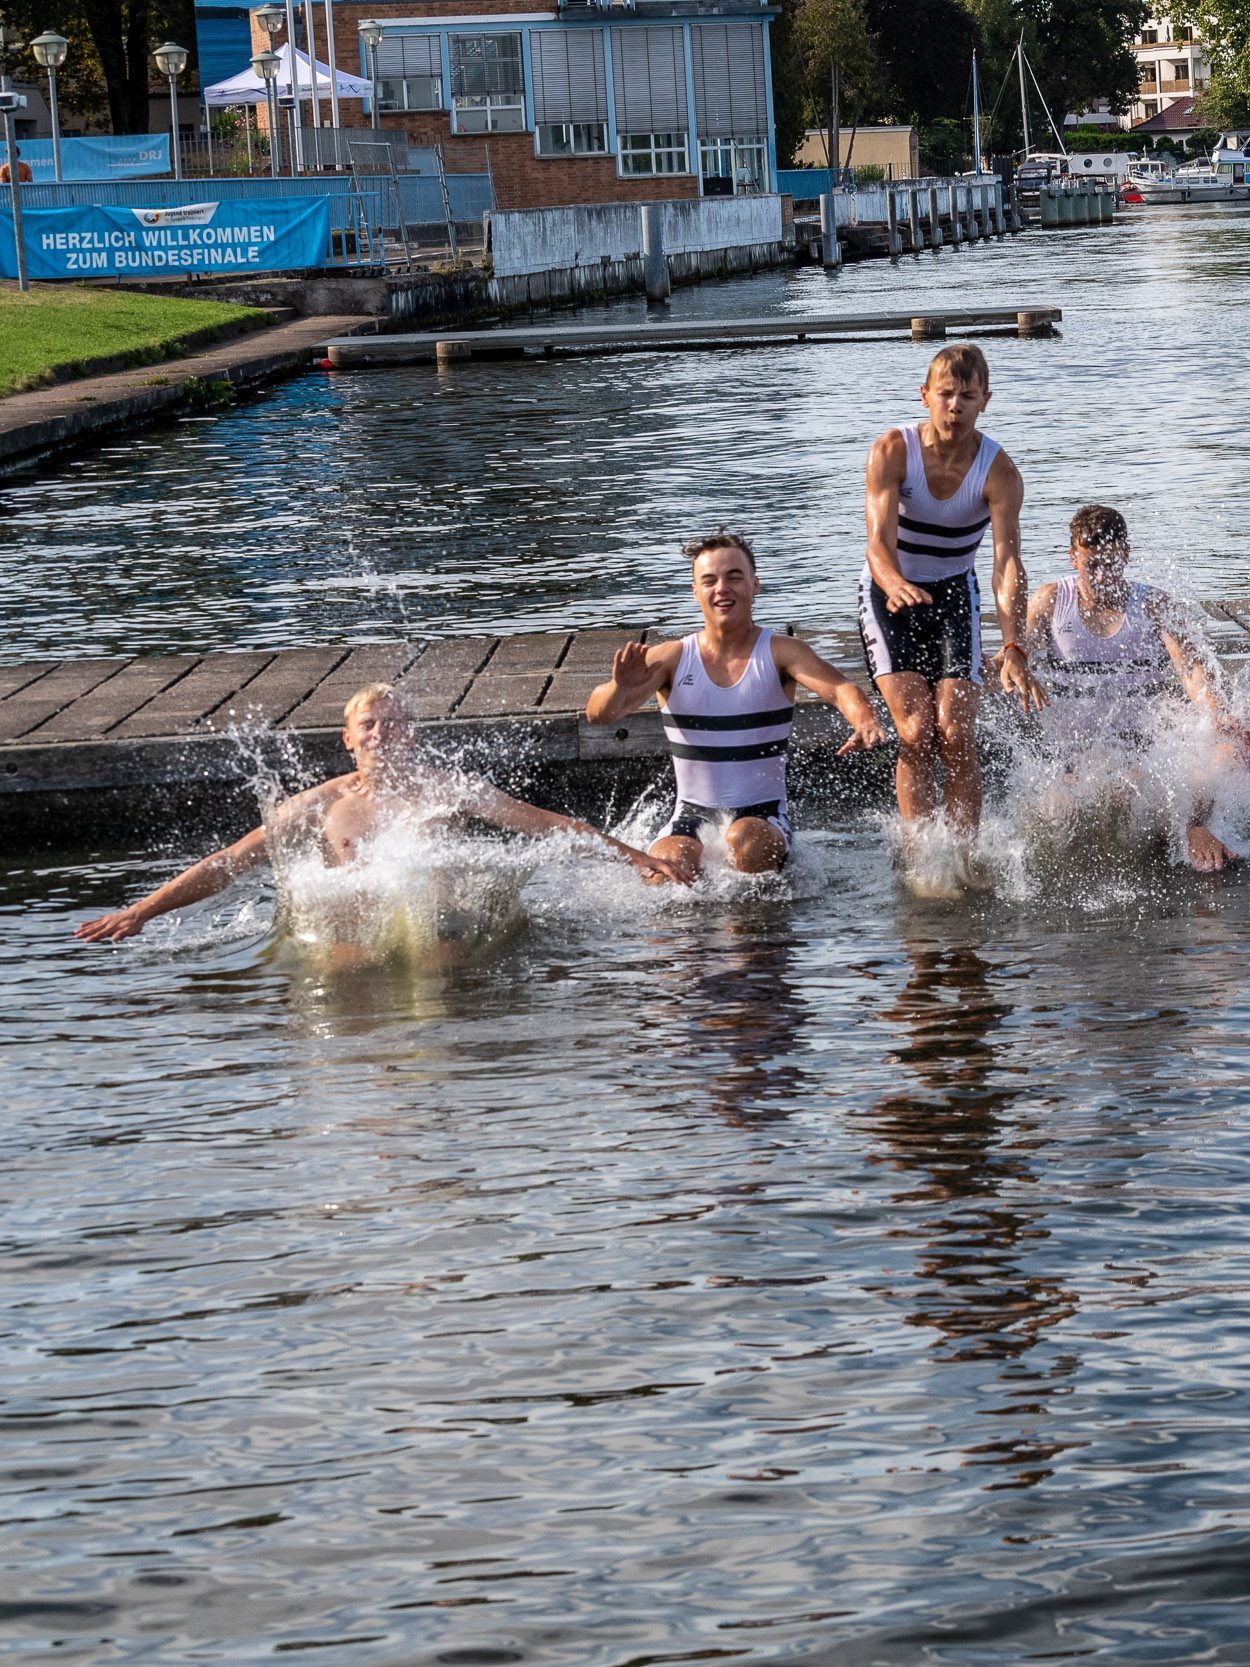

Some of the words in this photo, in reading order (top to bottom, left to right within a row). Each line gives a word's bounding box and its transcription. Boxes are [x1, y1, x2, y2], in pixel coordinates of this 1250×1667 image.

[138, 150, 162, 161] DRJ
[42, 231, 136, 249] HERZLICH
[142, 225, 275, 247] WILLKOMMEN
[66, 253, 108, 269] ZUM
[114, 246, 260, 268] BUNDESFINALE
